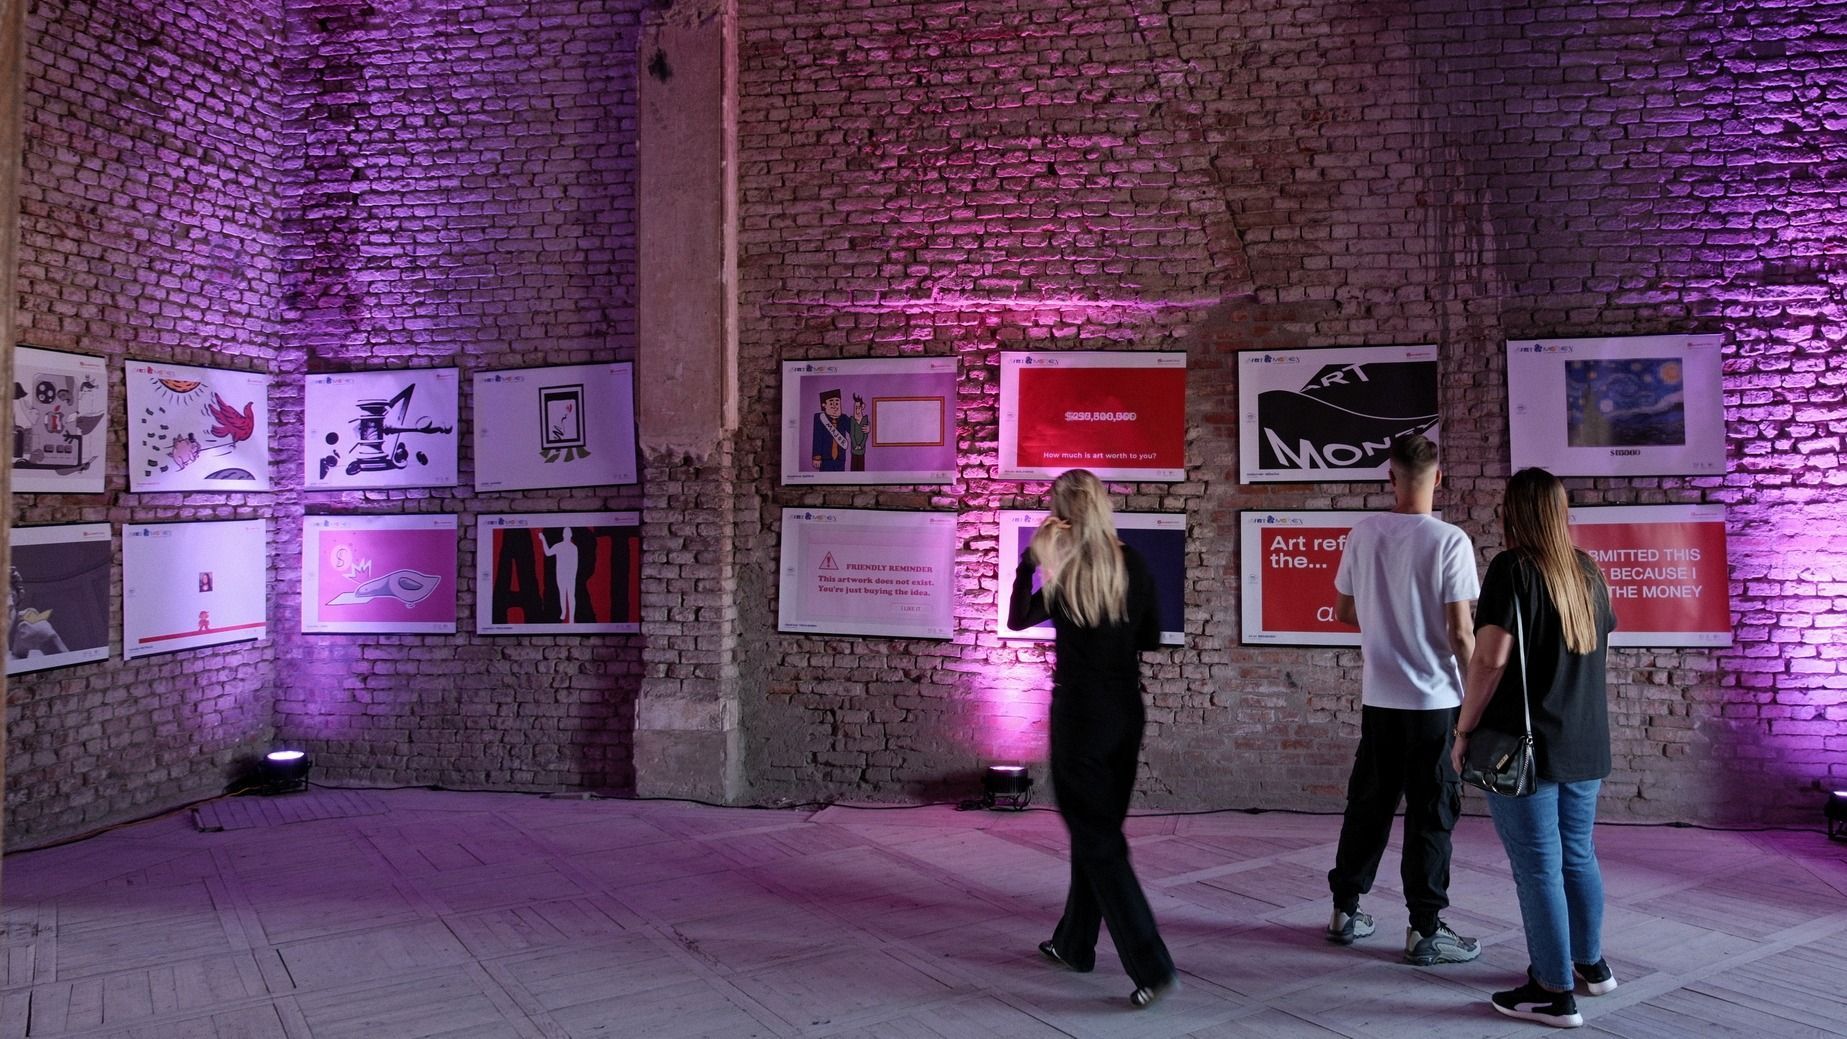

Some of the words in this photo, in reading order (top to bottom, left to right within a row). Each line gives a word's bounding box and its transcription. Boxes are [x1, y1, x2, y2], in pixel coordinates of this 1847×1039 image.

[1301, 363, 1370, 392] ART
[825, 423, 847, 447] MAJOR
[1105, 452, 1128, 460] worth
[1139, 453, 1157, 461] you?
[1270, 536, 1306, 551] Art
[1314, 535, 1347, 551] ref
[1270, 553, 1327, 568] the...
[1588, 549, 1659, 562] BMITTED
[1664, 548, 1701, 561] THIS
[846, 563, 887, 572] FRIENDLY
[889, 564, 933, 573] REMINDER
[1610, 567, 1688, 580] BECAUSE
[1692, 567, 1696, 579] I
[818, 575, 836, 583] This
[837, 576, 873, 584] artwork
[875, 577, 893, 585] does
[911, 578, 934, 586] exist.
[818, 585, 844, 593] You're
[845, 586, 862, 595] just
[863, 587, 893, 596] buying
[895, 588, 908, 596] the
[910, 588, 930, 597] idea.
[1608, 586, 1638, 598] THE
[1643, 585, 1702, 598] MONEY
